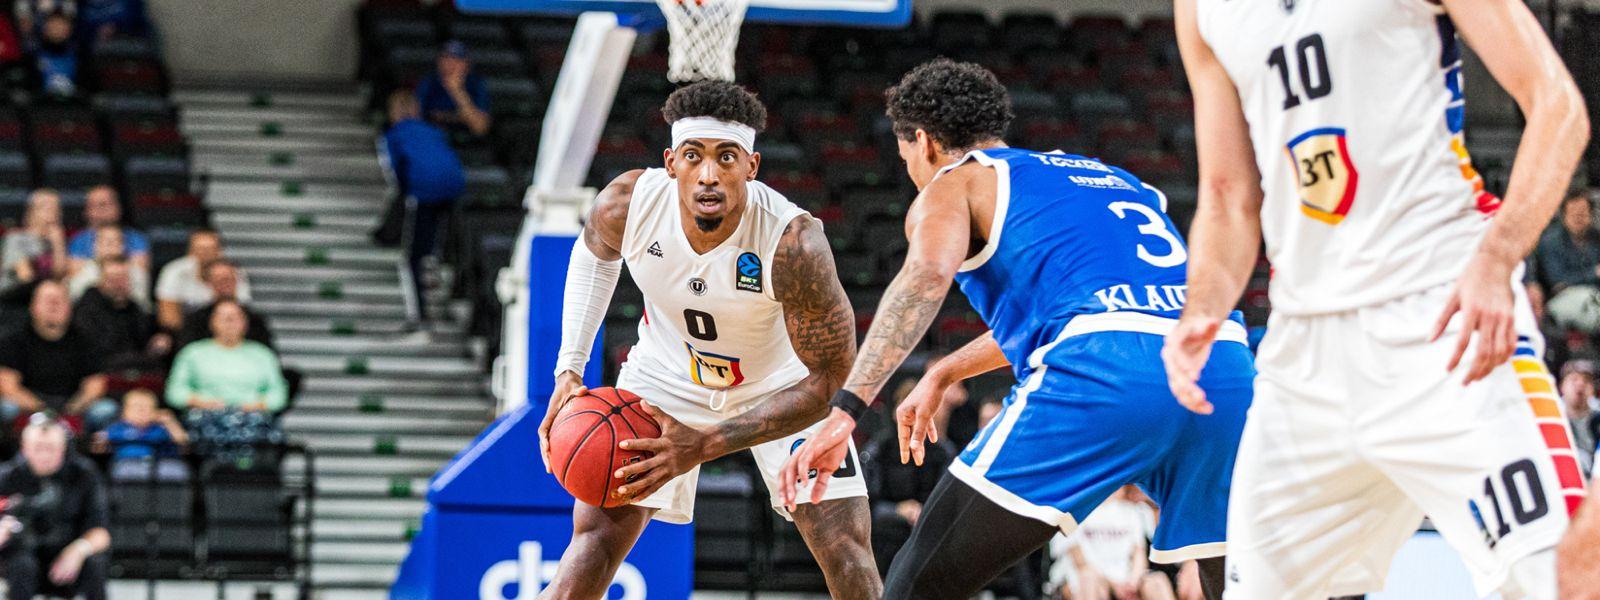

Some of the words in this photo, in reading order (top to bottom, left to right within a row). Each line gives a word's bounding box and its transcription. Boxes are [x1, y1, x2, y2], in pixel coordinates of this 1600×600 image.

[1266, 33, 1332, 110] 10
[647, 248, 664, 258] PEAK
[1107, 201, 1187, 267] 3
[683, 309, 718, 341] 0
[1484, 458, 1549, 540] 10
